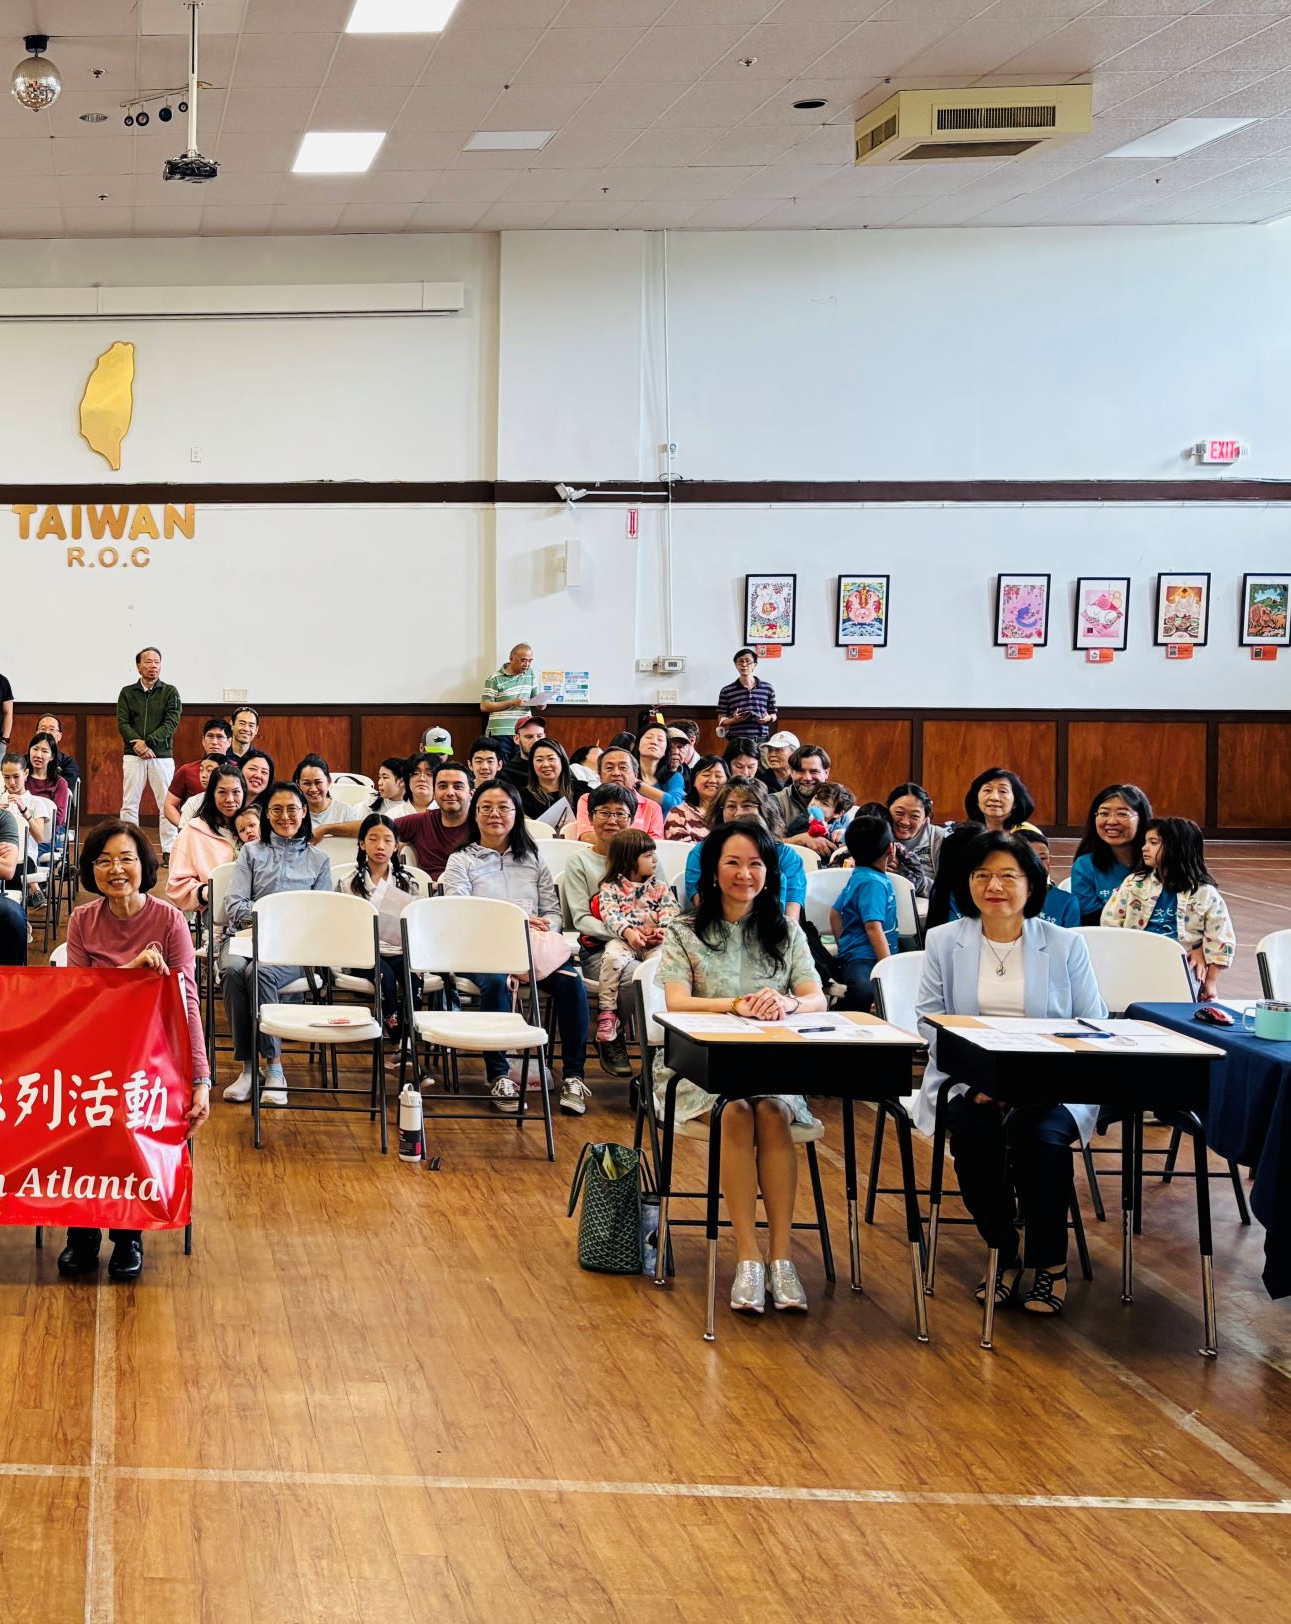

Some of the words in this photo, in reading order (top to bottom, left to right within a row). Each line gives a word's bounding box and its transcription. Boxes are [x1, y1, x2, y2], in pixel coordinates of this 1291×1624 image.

[1210, 441, 1236, 459] EXIT
[12, 503, 196, 540] TAIWAN
[67, 546, 150, 568] R.O.C
[15, 1166, 161, 1203] Atlanta
